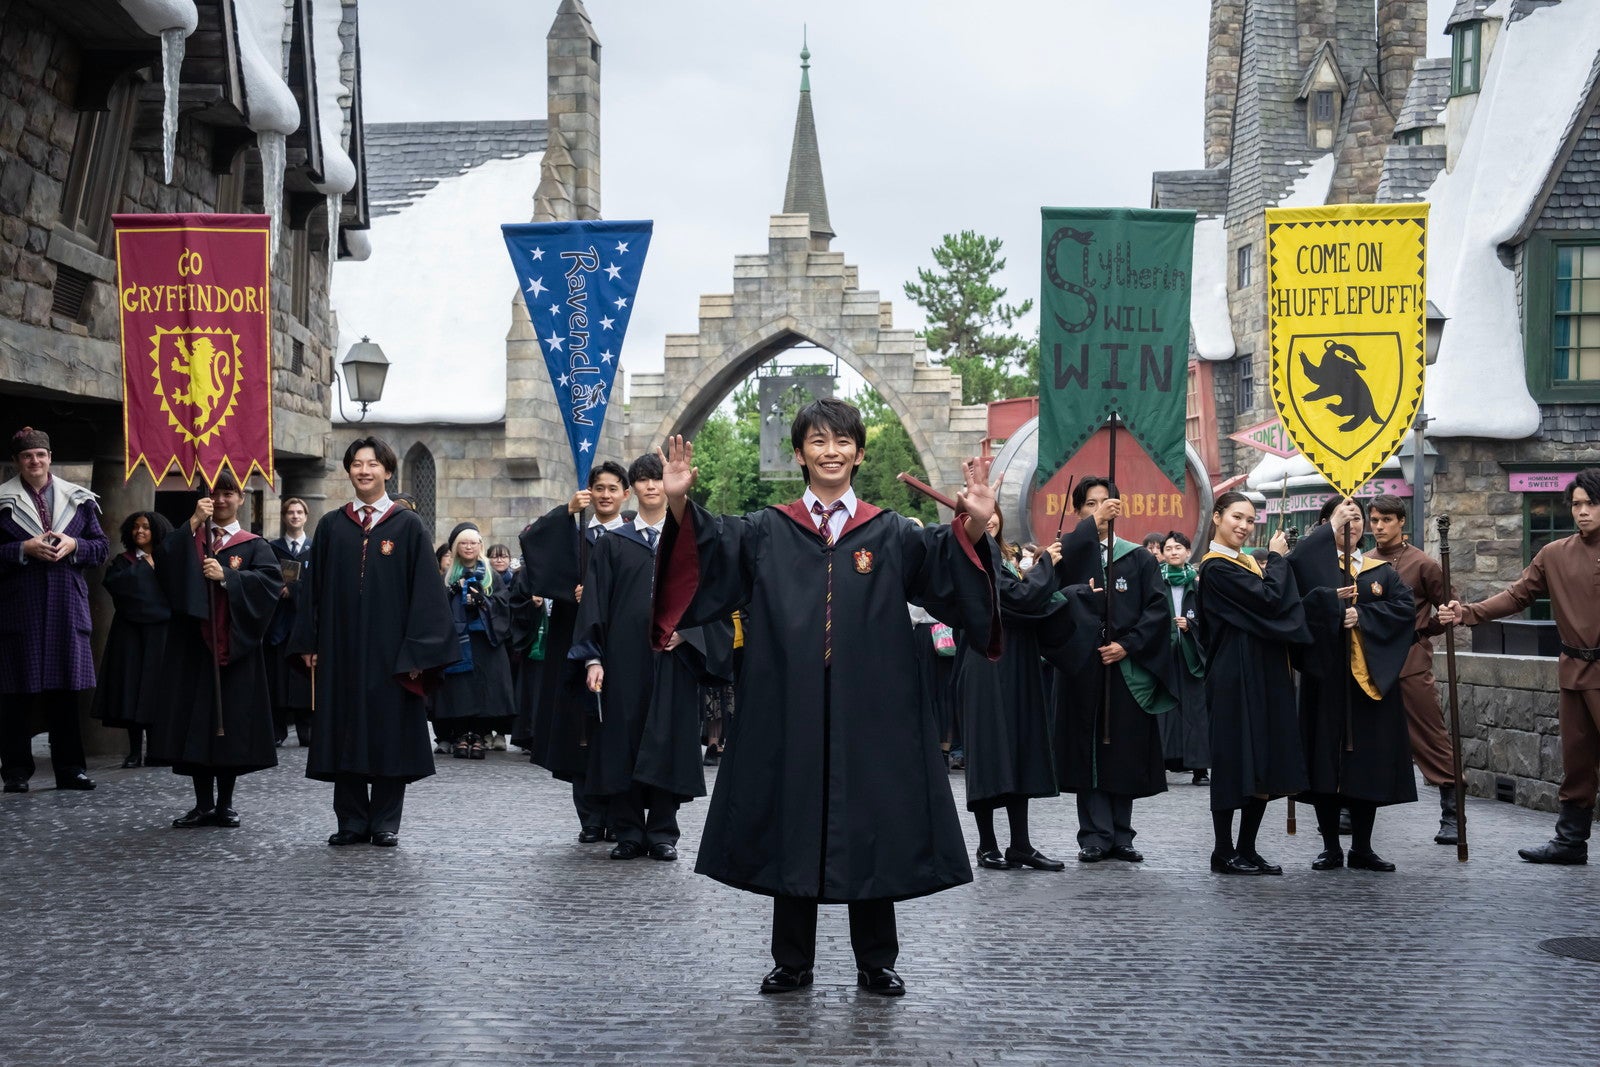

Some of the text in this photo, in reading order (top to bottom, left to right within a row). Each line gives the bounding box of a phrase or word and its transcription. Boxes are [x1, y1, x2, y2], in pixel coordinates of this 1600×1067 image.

[177, 248, 203, 277] GO
[1296, 241, 1383, 274] COME ON
[1046, 226, 1186, 334] Slytherin
[122, 281, 264, 315] GRYFFINDOR!
[1276, 284, 1417, 317] HUFFLEPUFF!
[1104, 305, 1164, 333] WILL
[560, 246, 600, 427] Ravenclaw
[1054, 343, 1173, 392] WIN
[1045, 493, 1184, 518] BURBEER
